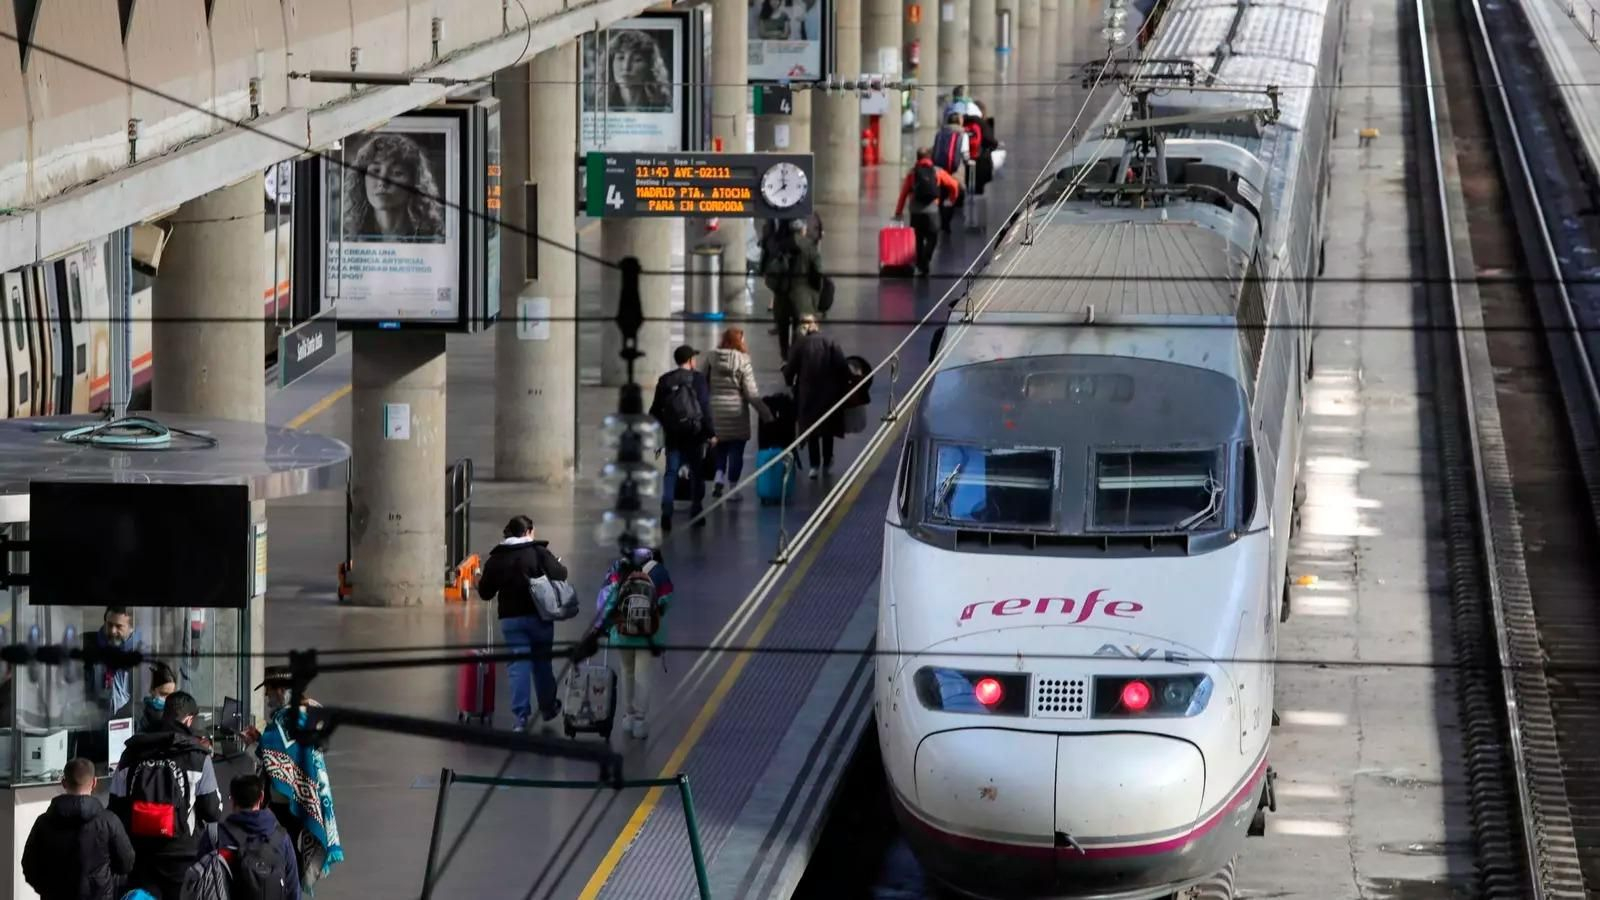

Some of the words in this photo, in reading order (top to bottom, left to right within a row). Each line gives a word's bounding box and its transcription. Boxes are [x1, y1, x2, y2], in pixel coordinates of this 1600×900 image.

[779, 98, 791, 115] 4
[674, 166, 731, 178] AVE-02111
[605, 184, 625, 210] 4
[636, 187, 675, 198] MADRID
[711, 187, 751, 198] ATOCHA
[649, 200, 675, 211] PARA
[680, 200, 694, 211] EN
[699, 200, 745, 212] CORDOBA
[960, 588, 1144, 625] renfe
[1093, 644, 1190, 666] AVE
